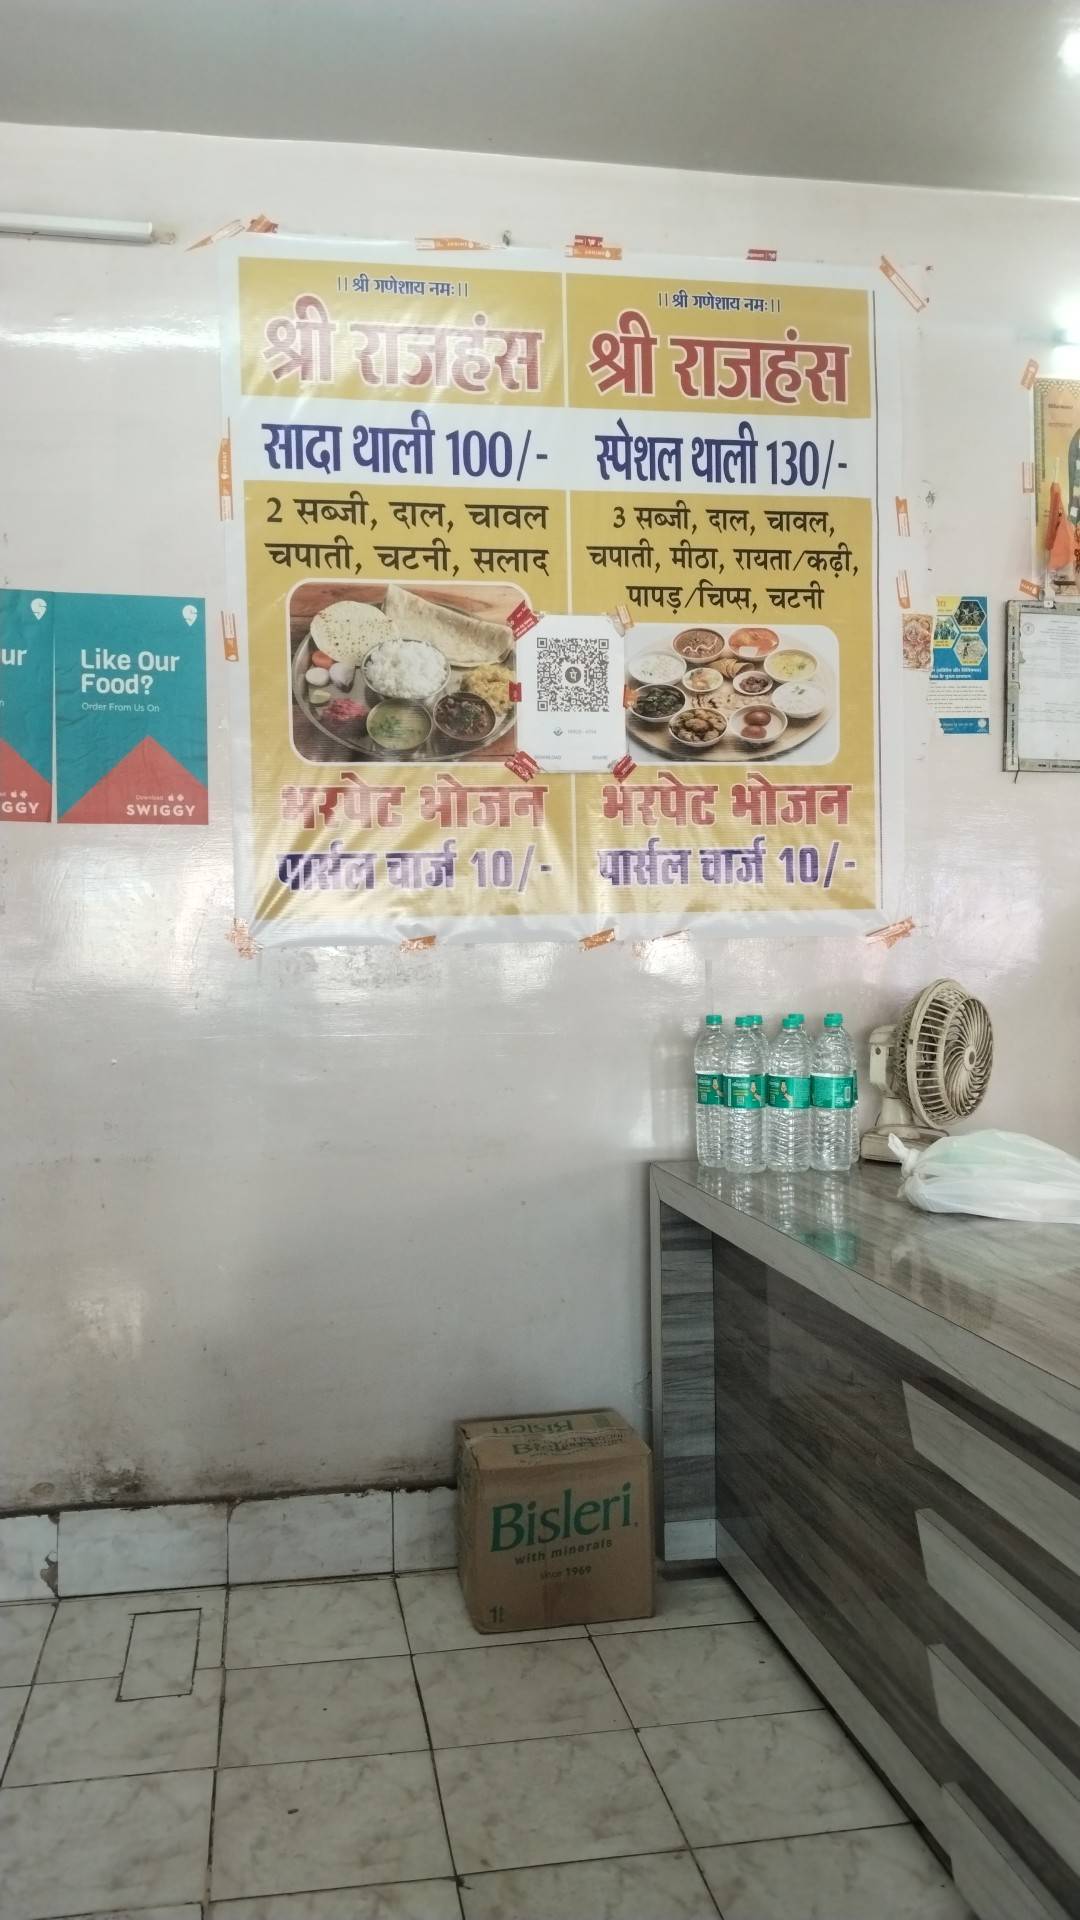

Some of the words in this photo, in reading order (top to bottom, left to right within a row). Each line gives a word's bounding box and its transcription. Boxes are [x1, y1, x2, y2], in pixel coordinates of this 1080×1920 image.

[374, 275, 425, 295] गणेशाय
[692, 292, 740, 310] गणेशाय
[263, 293, 337, 383] श्री
[350, 311, 545, 393] राजहंस
[585, 308, 658, 397] श्री
[668, 326, 852, 405] राजहंस
[261, 422, 342, 474] सादा
[352, 409, 435, 475] थाली
[446, 429, 548, 481] 100/-
[595, 417, 684, 483] स्पेशल
[691, 421, 758, 485] थाली
[766, 439, 848, 490] 130/-
[267, 497, 283, 523] 2
[293, 490, 378, 531] सब्जी,
[389, 500, 454, 532] दाल,
[465, 503, 549, 530] चावल
[613, 506, 626, 528] 3
[633, 500, 697, 534] सब्जी,
[706, 508, 756, 535] दाल,
[764, 509, 835, 538] चावल,
[264, 535, 362, 574] चपाती,
[373, 537, 460, 576] चटनी,
[470, 547, 550, 576] सलाद
[586, 538, 661, 572] चपाती,
[669, 539, 724, 574] मीठा,
[766, 580, 824, 611] चटनी
[81, 648, 131, 670] Like
[138, 651, 180, 671] Our
[81, 673, 153, 695] Food?
[82, 702, 106, 711] Order
[109, 703, 131, 712] From
[134, 704, 145, 712] Us
[147, 704, 160, 713] On
[126, 804, 196, 817] SWIGGY
[280, 770, 406, 829] भरपेट
[418, 770, 549, 829] भोजन
[601, 770, 719, 827] भरपेट
[730, 770, 852, 827] भोजन
[275, 839, 378, 891] पार्सल
[385, 838, 458, 890] चार्ज
[470, 844, 553, 893] 10/-
[597, 837, 692, 888] पार्सल
[698, 836, 766, 887] चार्ज
[778, 840, 857, 889] 10/-
[490, 1482, 632, 1552] Bisleri
[515, 1553, 546, 1566] with
[551, 1538, 613, 1559] minerals
[540, 1570, 562, 1580] since
[566, 1565, 592, 1577] 1969
